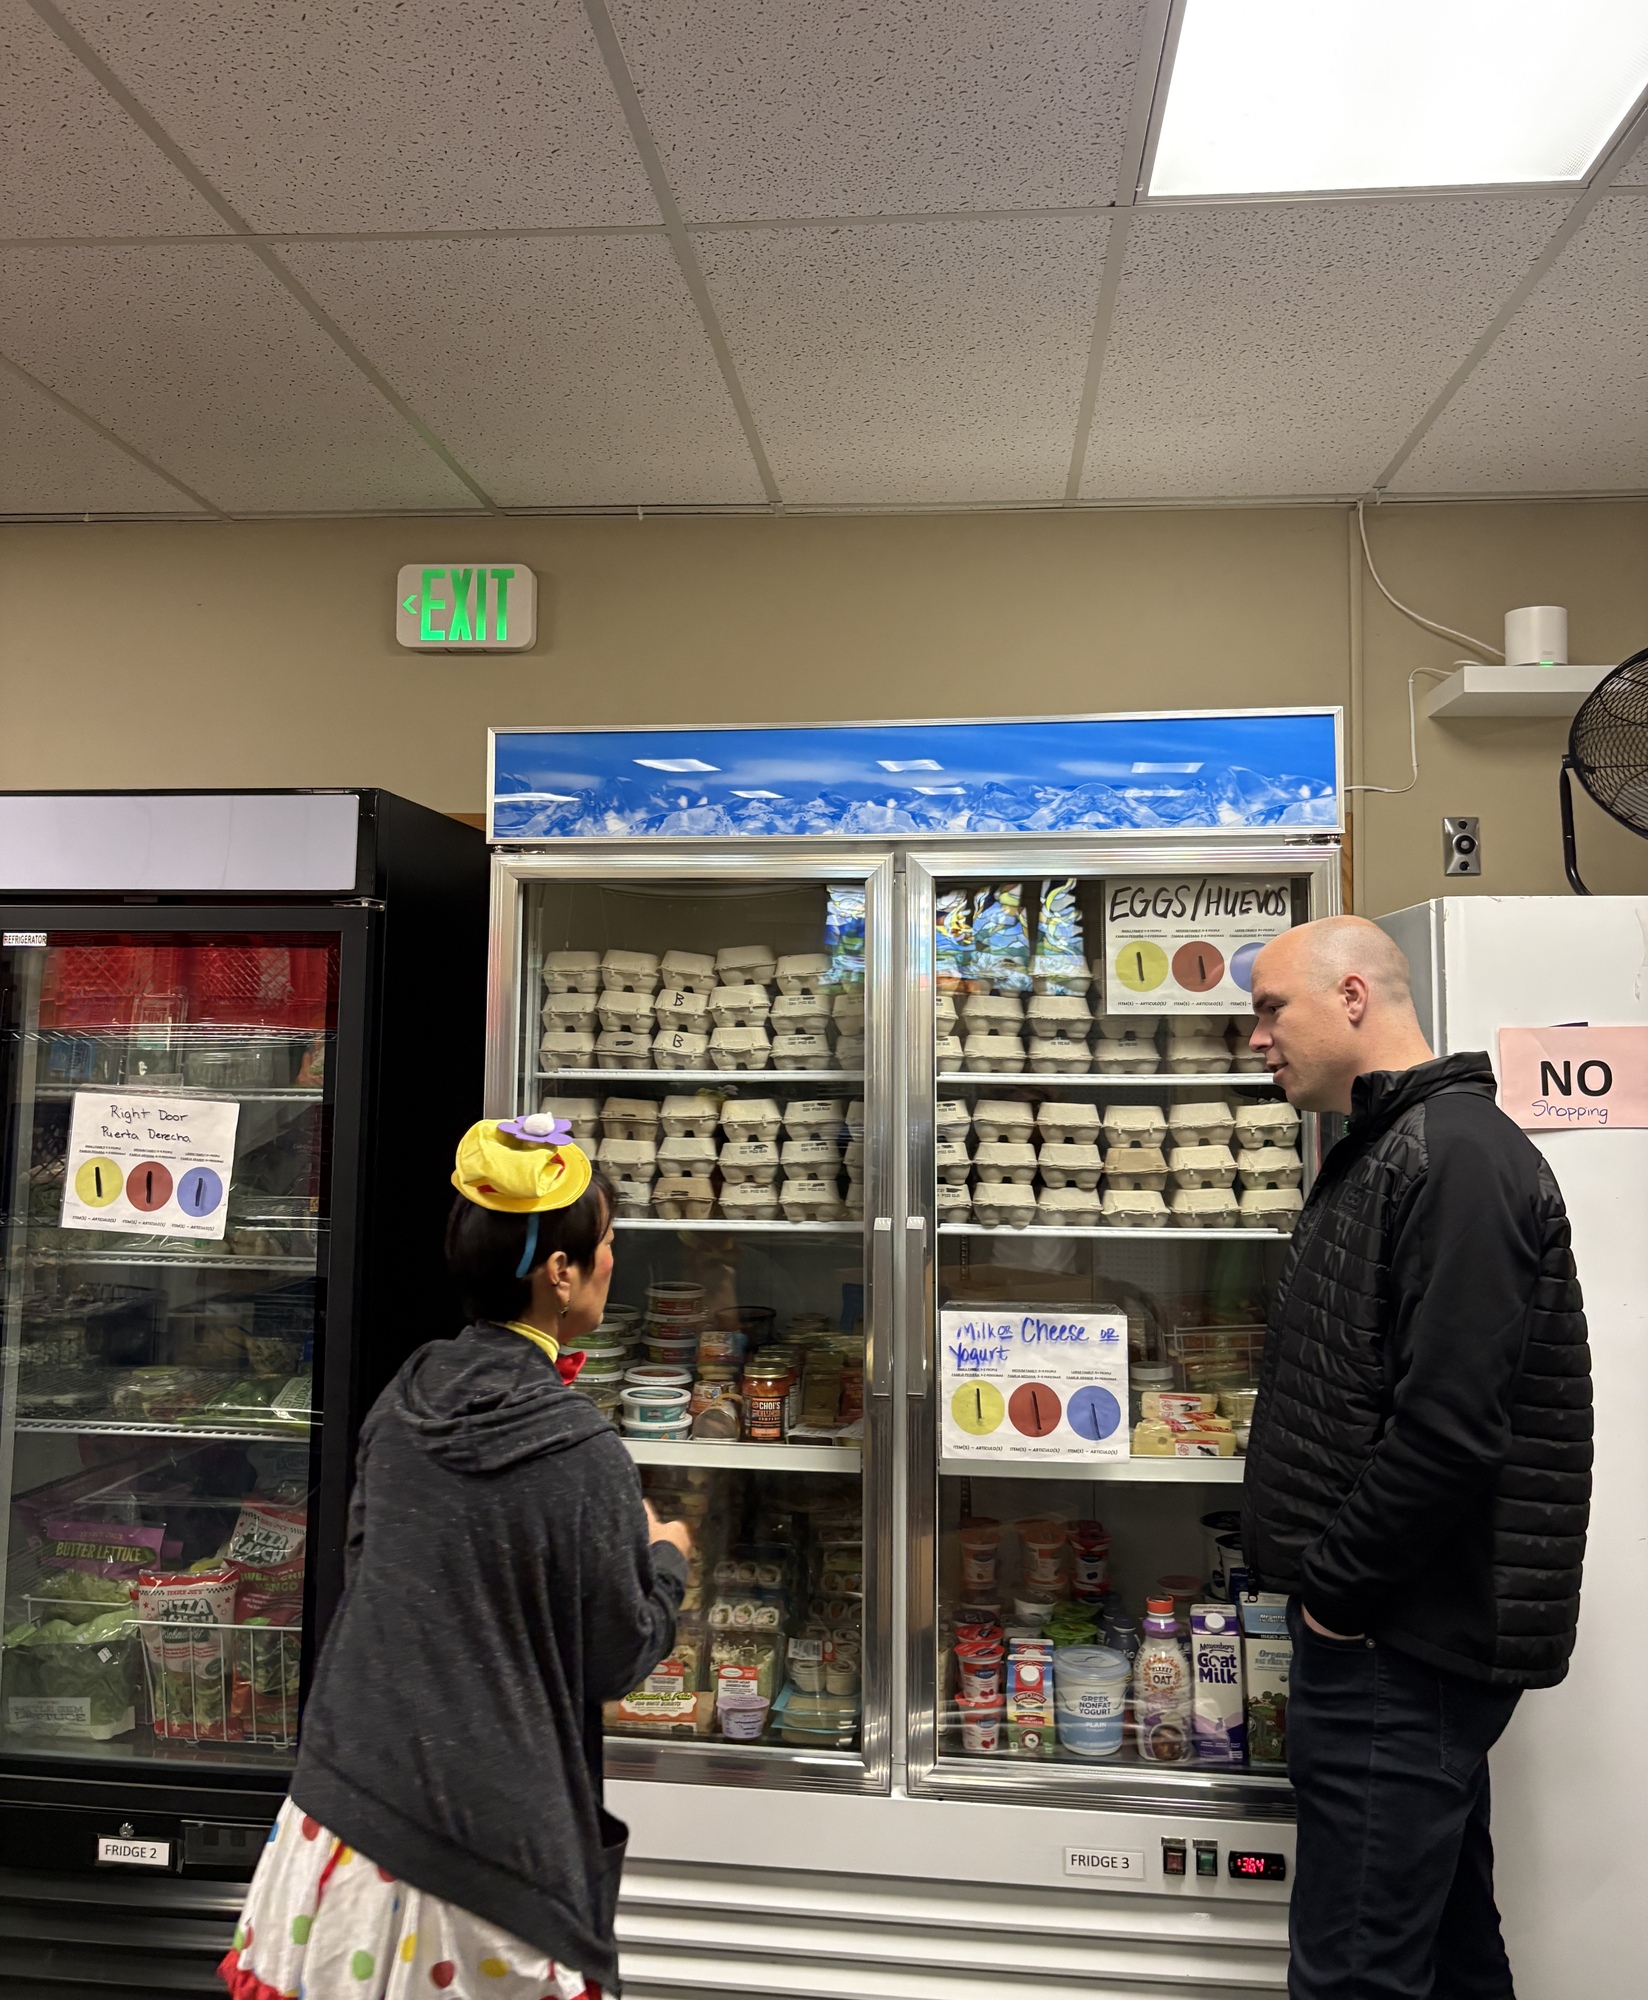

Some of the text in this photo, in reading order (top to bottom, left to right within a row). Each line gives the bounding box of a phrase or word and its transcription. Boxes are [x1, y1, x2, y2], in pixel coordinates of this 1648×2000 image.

[420, 568, 516, 641] EXIT
[3, 933, 47, 945] REFRIGERATOR
[673, 992, 685, 1007] B
[673, 1034, 684, 1048] B
[1540, 1060, 1613, 1096] NO
[110, 1104, 189, 1124] Right Door
[1531, 1100, 1609, 1124] Shopping
[101, 1126, 192, 1144] Puerta Derecha
[956, 1322, 997, 1341] Milk
[1022, 1317, 1090, 1343] Cheese
[1100, 1327, 1119, 1340] OR
[949, 1342, 1011, 1370] Yogurt
[759, 1401, 781, 1410] CHOI'S
[56, 1541, 141, 1562] BUTTER LETTUCE
[158, 1599, 210, 1615] PIZZA
[1197, 1653, 1238, 1669] Goat
[1152, 1675, 1173, 1685] OAT
[1198, 1668, 1240, 1685] Milk
[104, 1844, 157, 1859] FRIDGE 2
[1071, 1854, 1130, 1869] FRIDGE 3
